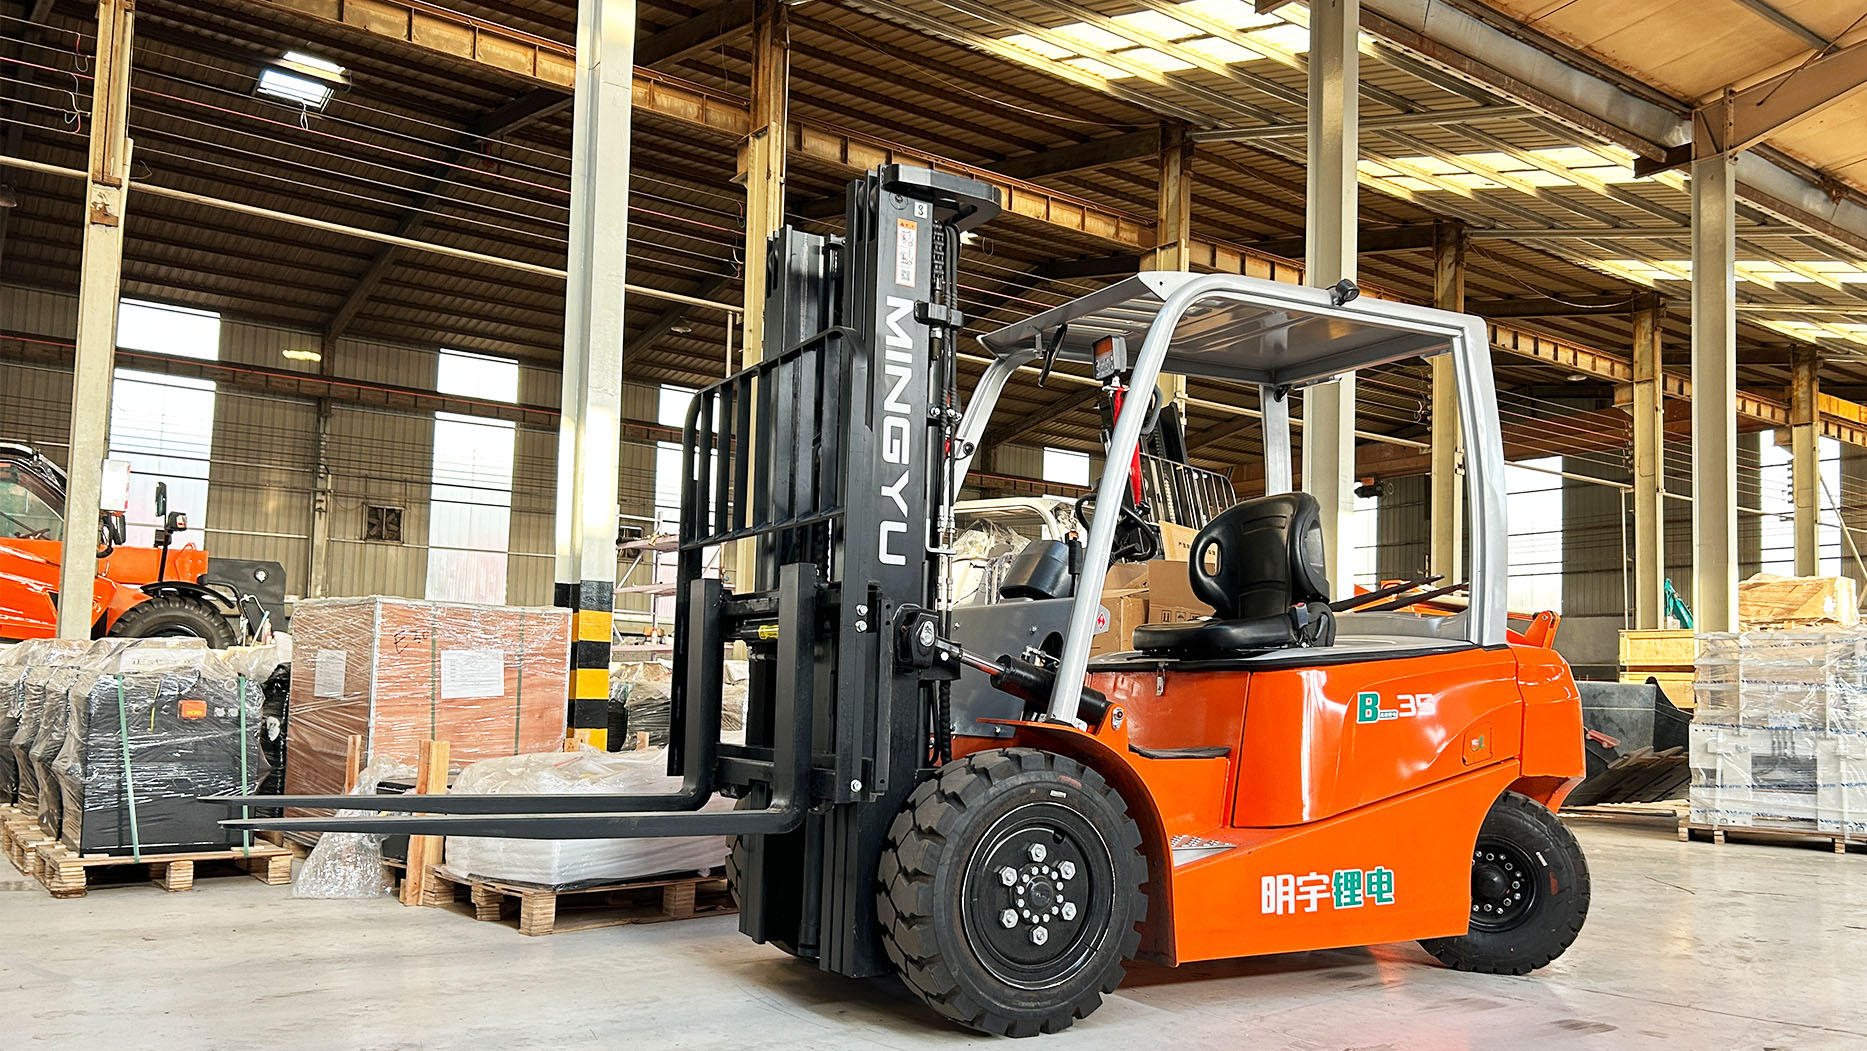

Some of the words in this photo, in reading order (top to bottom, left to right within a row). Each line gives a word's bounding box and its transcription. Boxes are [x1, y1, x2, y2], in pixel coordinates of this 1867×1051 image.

[878, 295, 914, 566] MINGYU
[1357, 691, 1380, 724] B
[1397, 693, 1436, 716] 35
[1261, 867, 1395, 915] 明宇锂电
